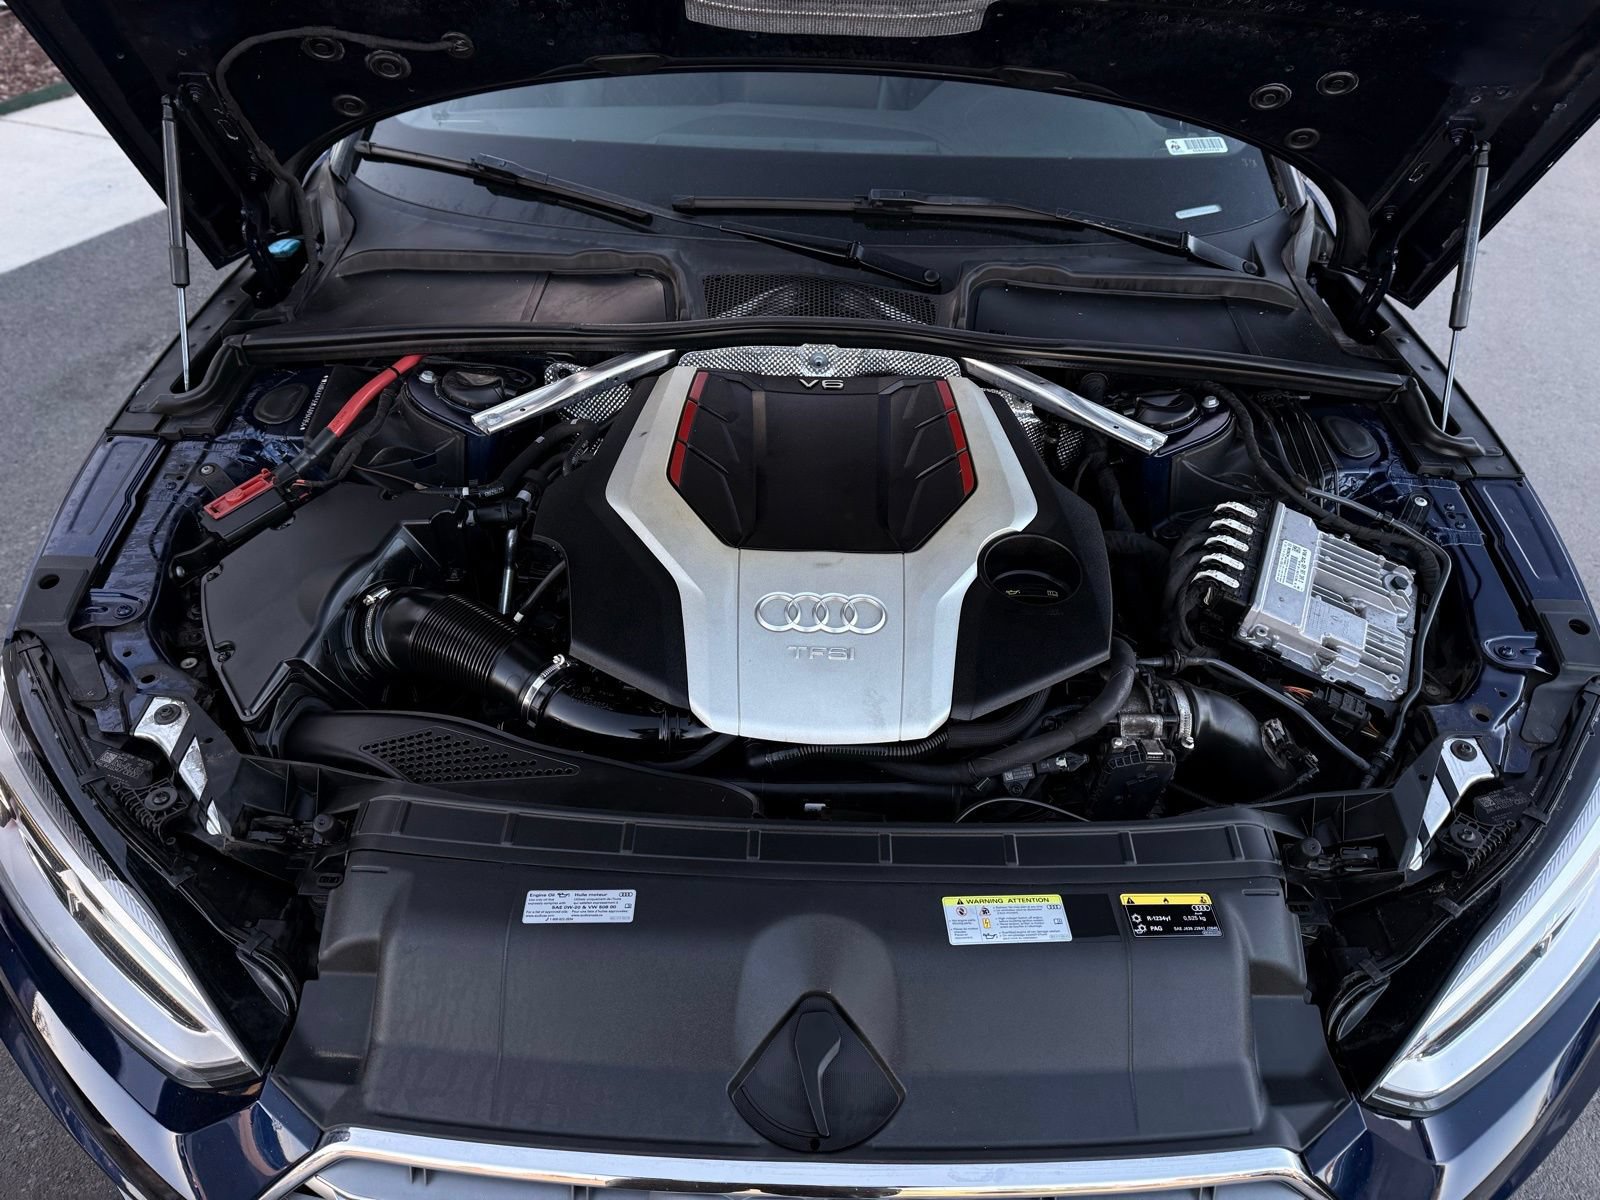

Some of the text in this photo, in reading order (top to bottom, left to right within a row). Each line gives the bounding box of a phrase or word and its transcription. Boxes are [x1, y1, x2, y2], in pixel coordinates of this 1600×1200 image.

[799, 379, 844, 390] V6
[787, 646, 855, 661] TFSI
[965, 896, 1050, 905] WARNING ATTENTION
